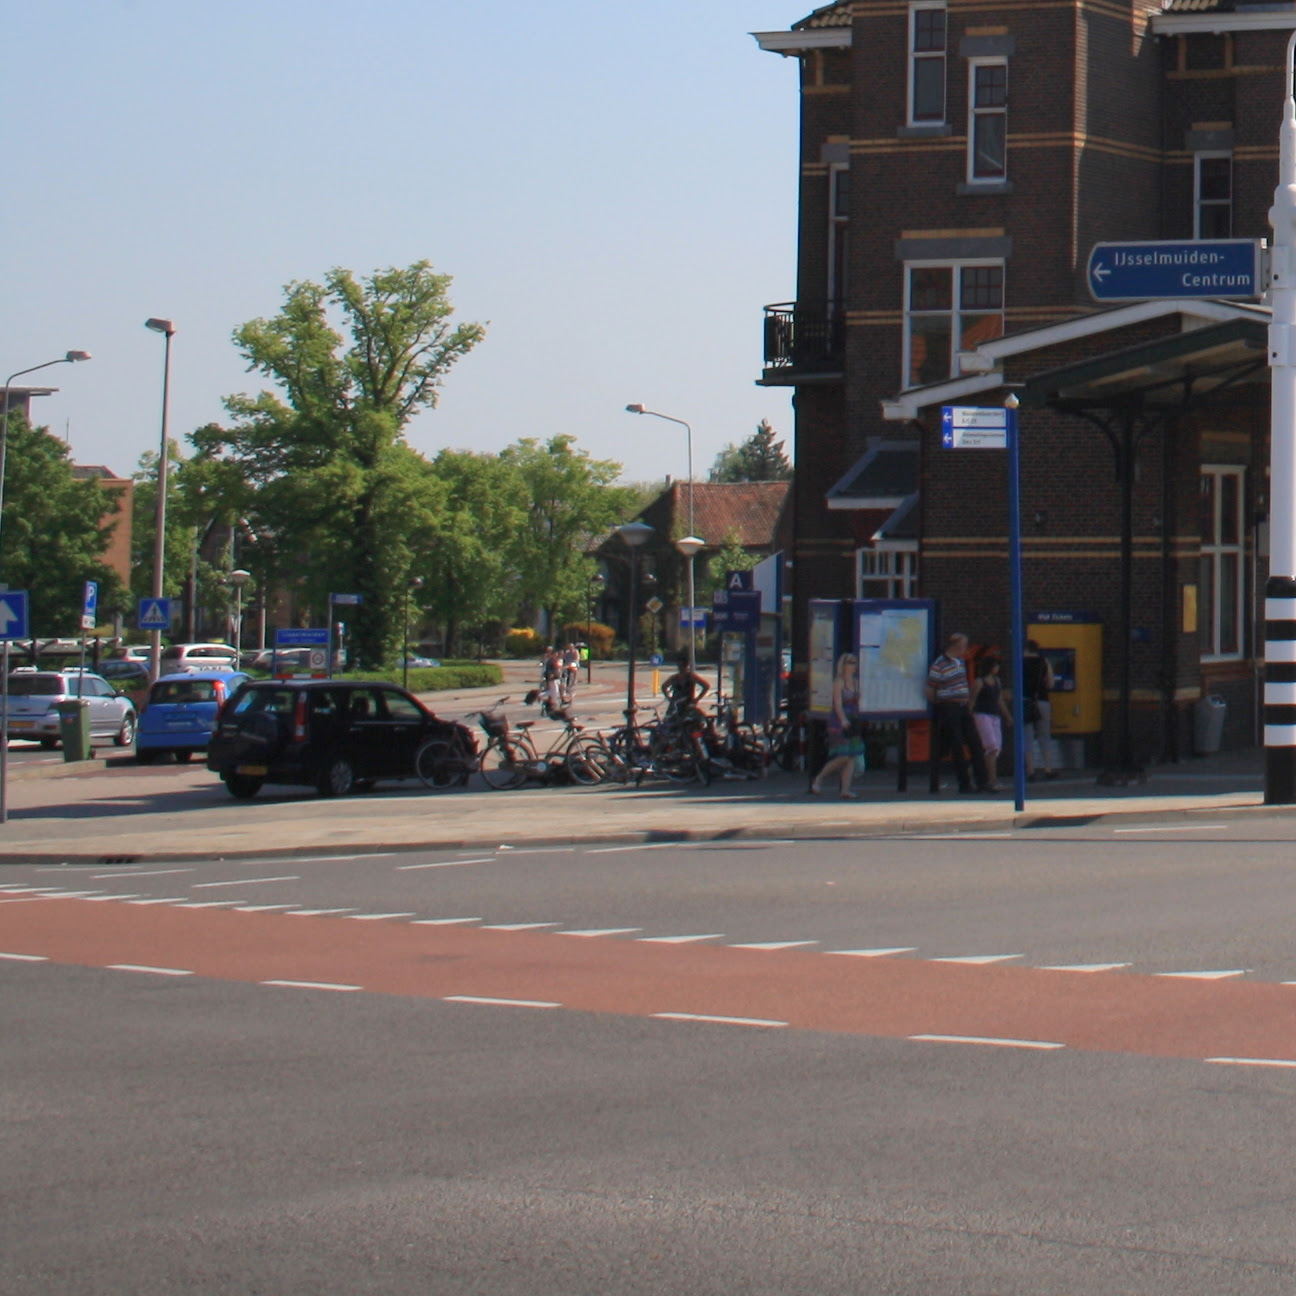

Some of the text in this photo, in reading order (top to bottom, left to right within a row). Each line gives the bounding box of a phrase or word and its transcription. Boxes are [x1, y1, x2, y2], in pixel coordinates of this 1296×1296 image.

[1114, 250, 1225, 266] IJsselmuiden-
[1182, 272, 1251, 287] Centrum
[729, 573, 744, 589] A
